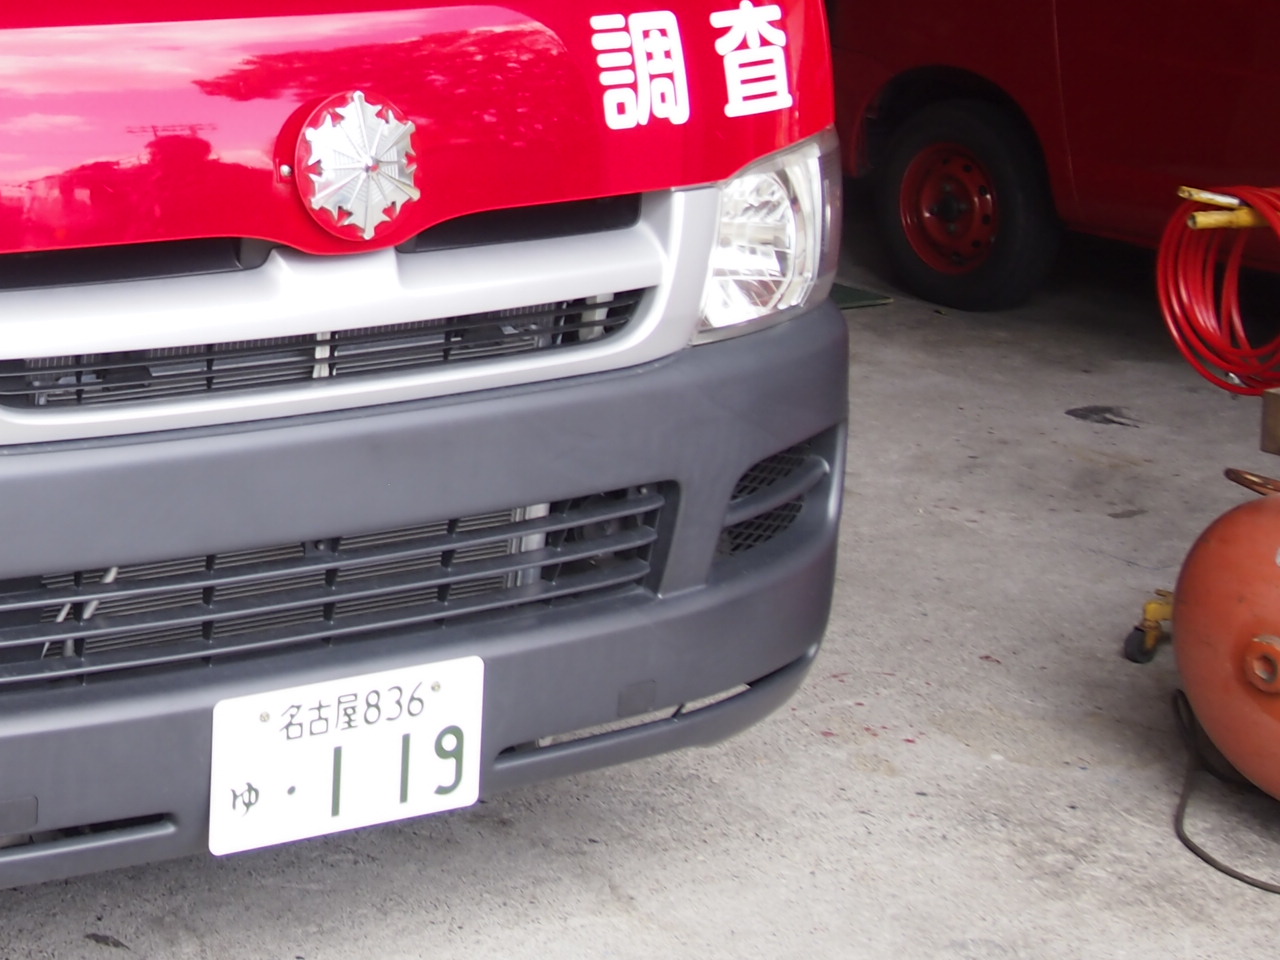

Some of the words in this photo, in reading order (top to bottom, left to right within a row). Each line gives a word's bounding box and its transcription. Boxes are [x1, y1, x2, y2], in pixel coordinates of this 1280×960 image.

[589, 0, 793, 130] 調査
[280, 682, 425, 740] 名古屋836
